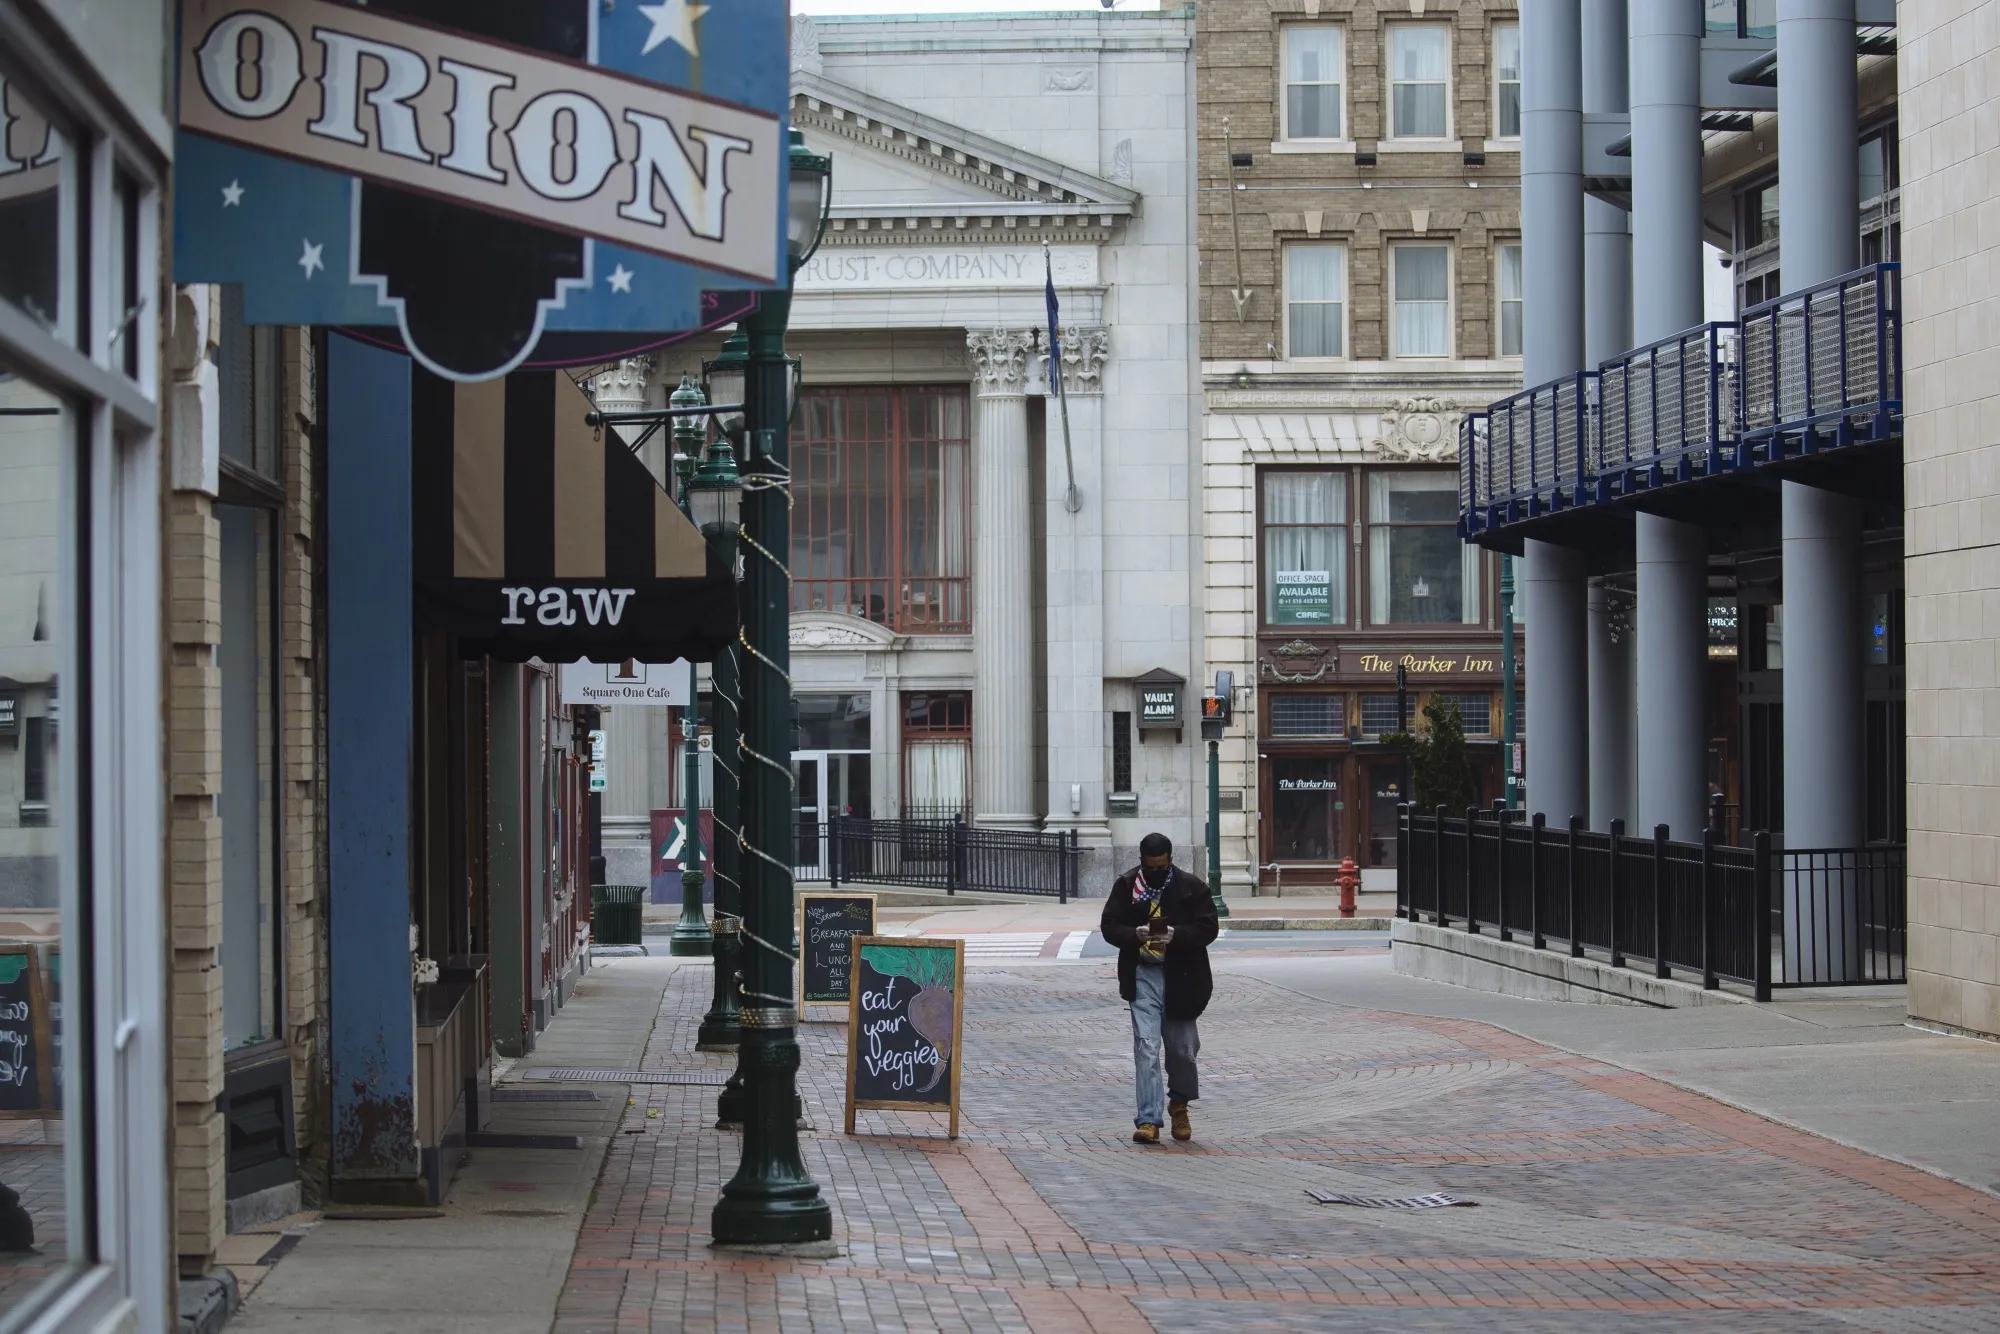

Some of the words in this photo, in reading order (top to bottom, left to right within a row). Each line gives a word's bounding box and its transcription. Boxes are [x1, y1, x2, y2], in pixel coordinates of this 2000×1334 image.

[193, 9, 751, 242] ORION
[806, 253, 876, 282] RUST
[886, 252, 1028, 282] COMPANY
[1278, 587, 1328, 596] AVAILABLE
[501, 586, 635, 626] raw
[1360, 654, 1393, 672] The
[1400, 654, 1456, 672] Parker
[1462, 655, 1494, 672] Inn
[582, 686, 621, 699] Square
[622, 687, 643, 698] One
[646, 687, 670, 698] Cafe
[1143, 693, 1174, 703] VAULT
[1143, 704, 1175, 715] ALARM
[1279, 779, 1295, 788] The
[1296, 779, 1323, 788] Parker
[1322, 780, 1337, 788] Inn
[811, 927, 863, 943] BREAKFAST
[830, 968, 845, 976] ALL
[830, 980, 843, 988] DAY
[862, 977, 903, 1010] eat
[864, 1016, 907, 1059] your
